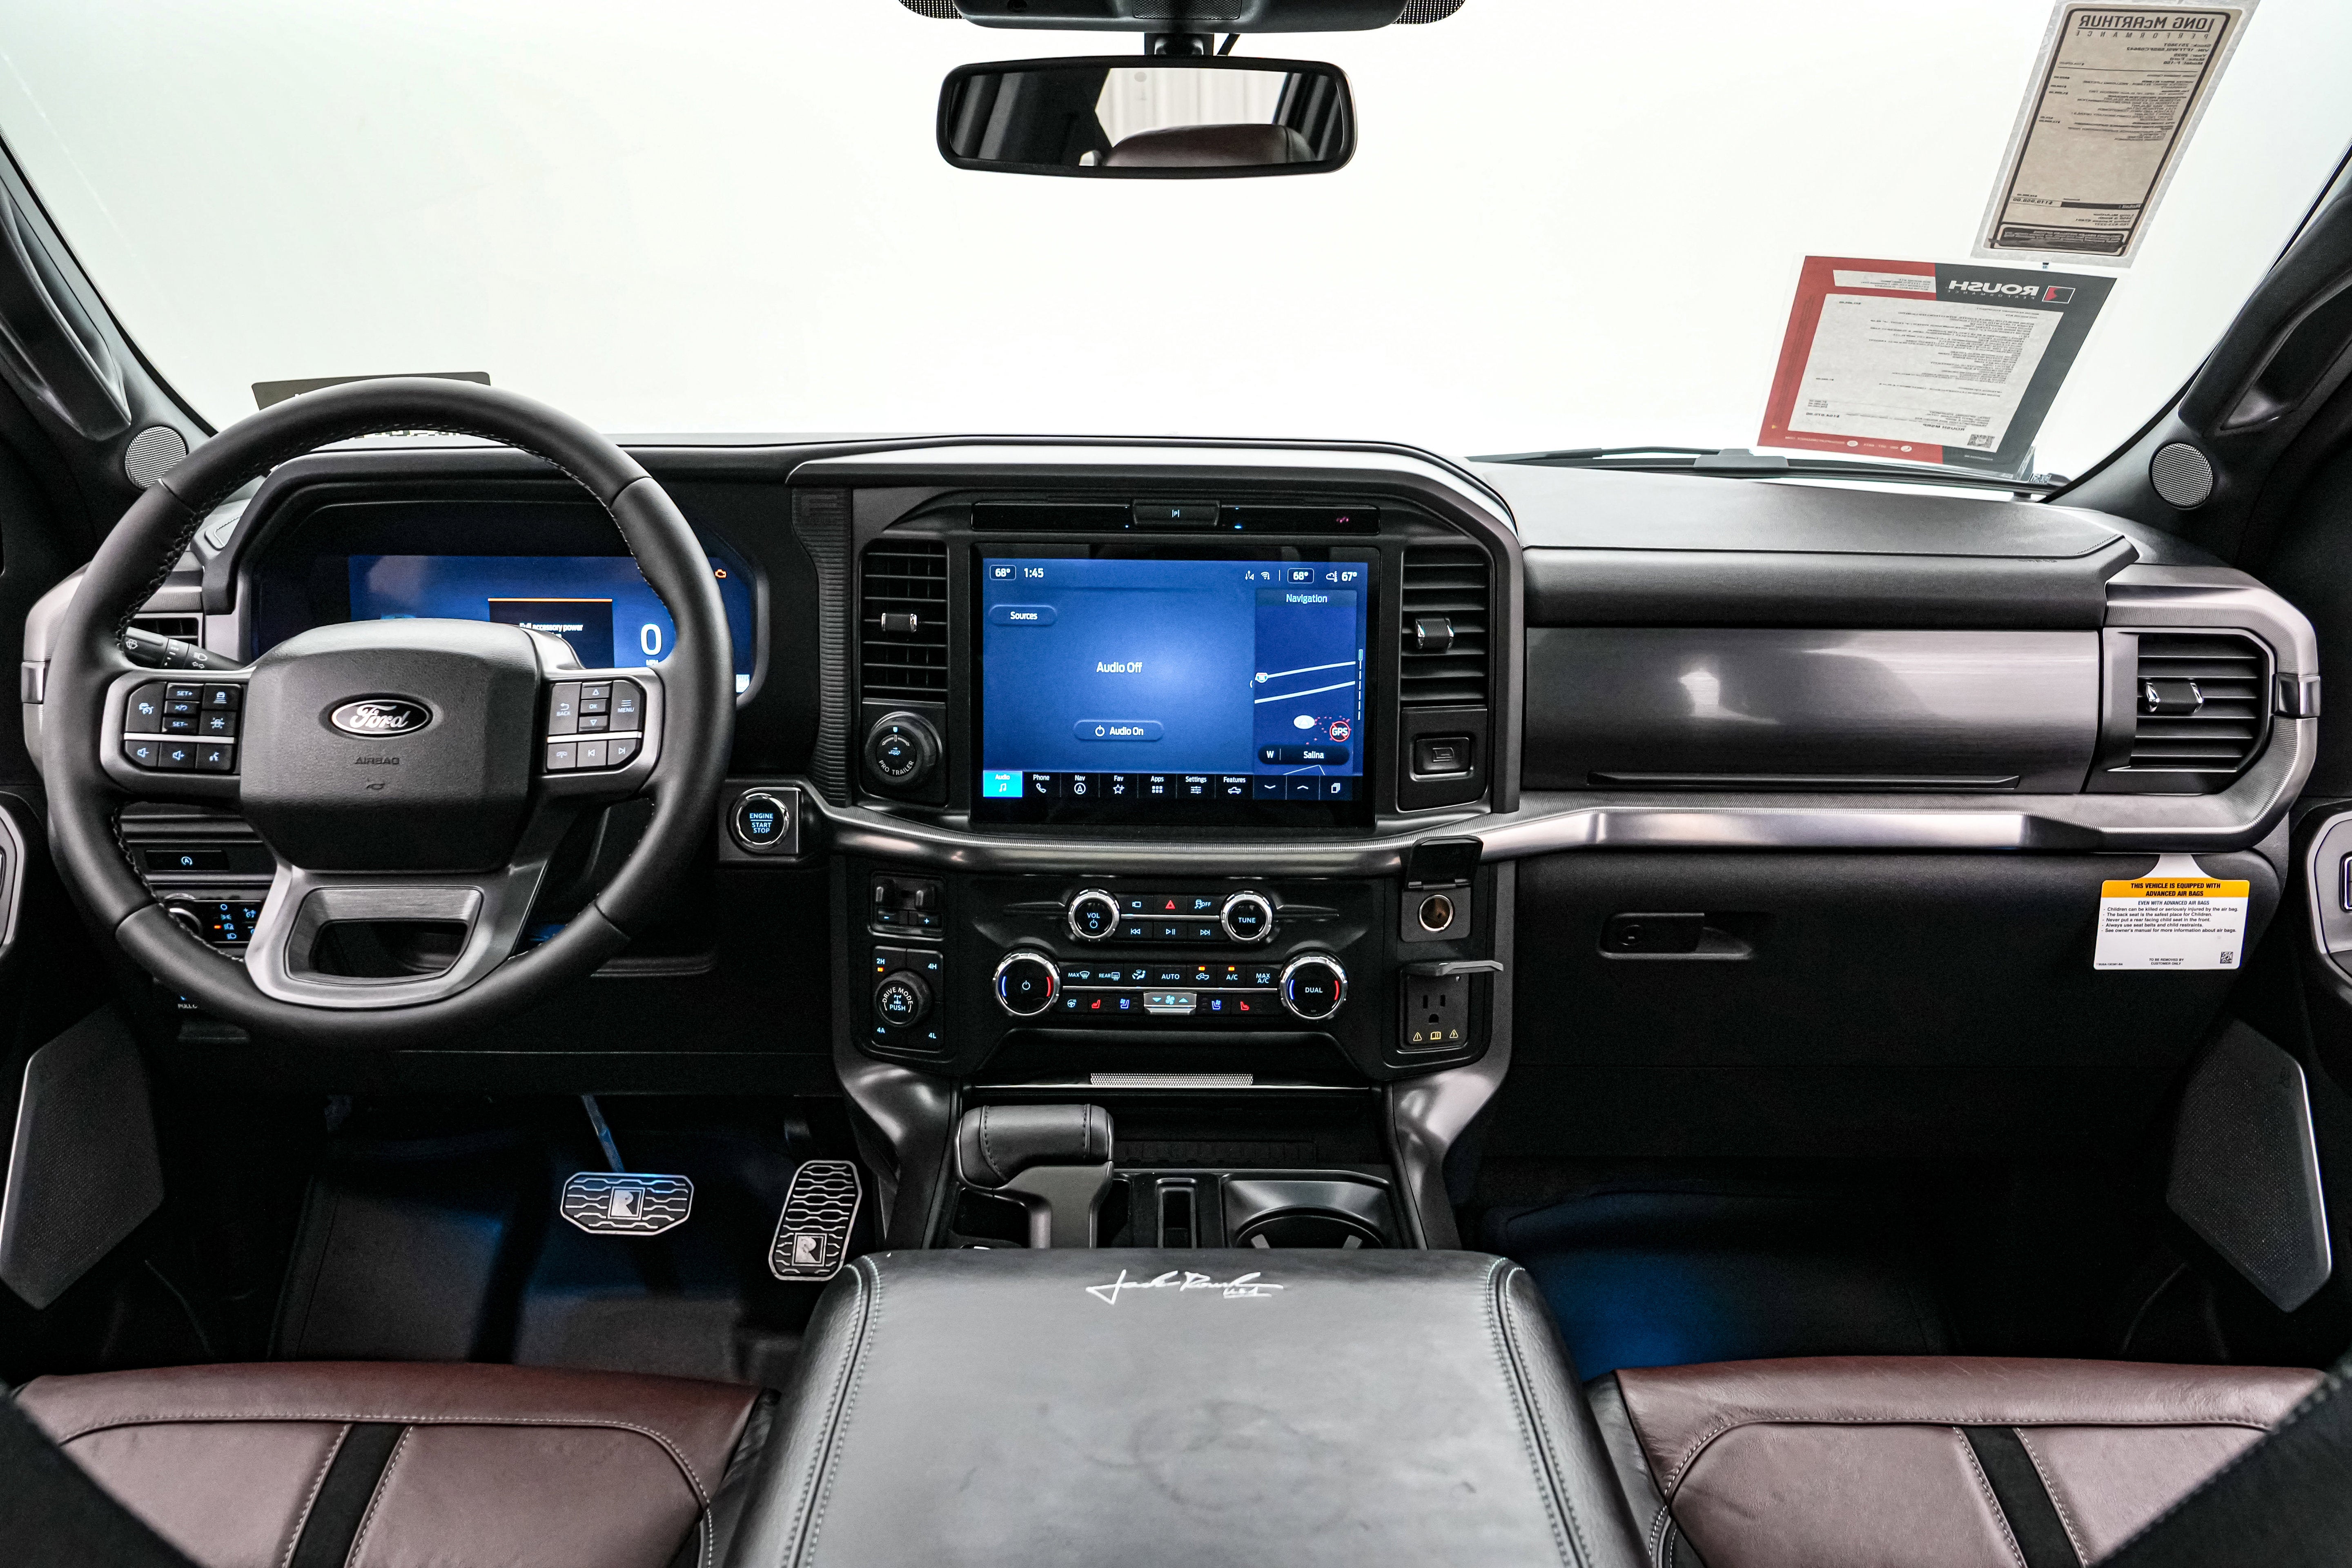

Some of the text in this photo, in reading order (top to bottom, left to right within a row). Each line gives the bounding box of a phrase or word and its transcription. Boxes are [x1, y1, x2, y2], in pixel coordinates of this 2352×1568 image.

[995, 568, 1011, 577] 68°
[1024, 568, 1044, 577] 1:45
[1293, 571, 1309, 580] 68°
[1341, 571, 1357, 581] 67°
[1286, 594, 1327, 604] Navigation
[1010, 611, 1038, 620] Sources
[532, 624, 563, 632] accessory
[563, 624, 584, 632] power
[640, 624, 662, 655] 0
[1096, 662, 1143, 673] Audio Off
[350, 704, 411, 728] Ford
[1109, 725, 1144, 735] Audio On
[1332, 727, 1348, 737] GPS
[1303, 751, 1324, 759] Salina
[878, 760, 914, 775] PRO TRAILER
[882, 987, 913, 1004] DRIVE MODE
